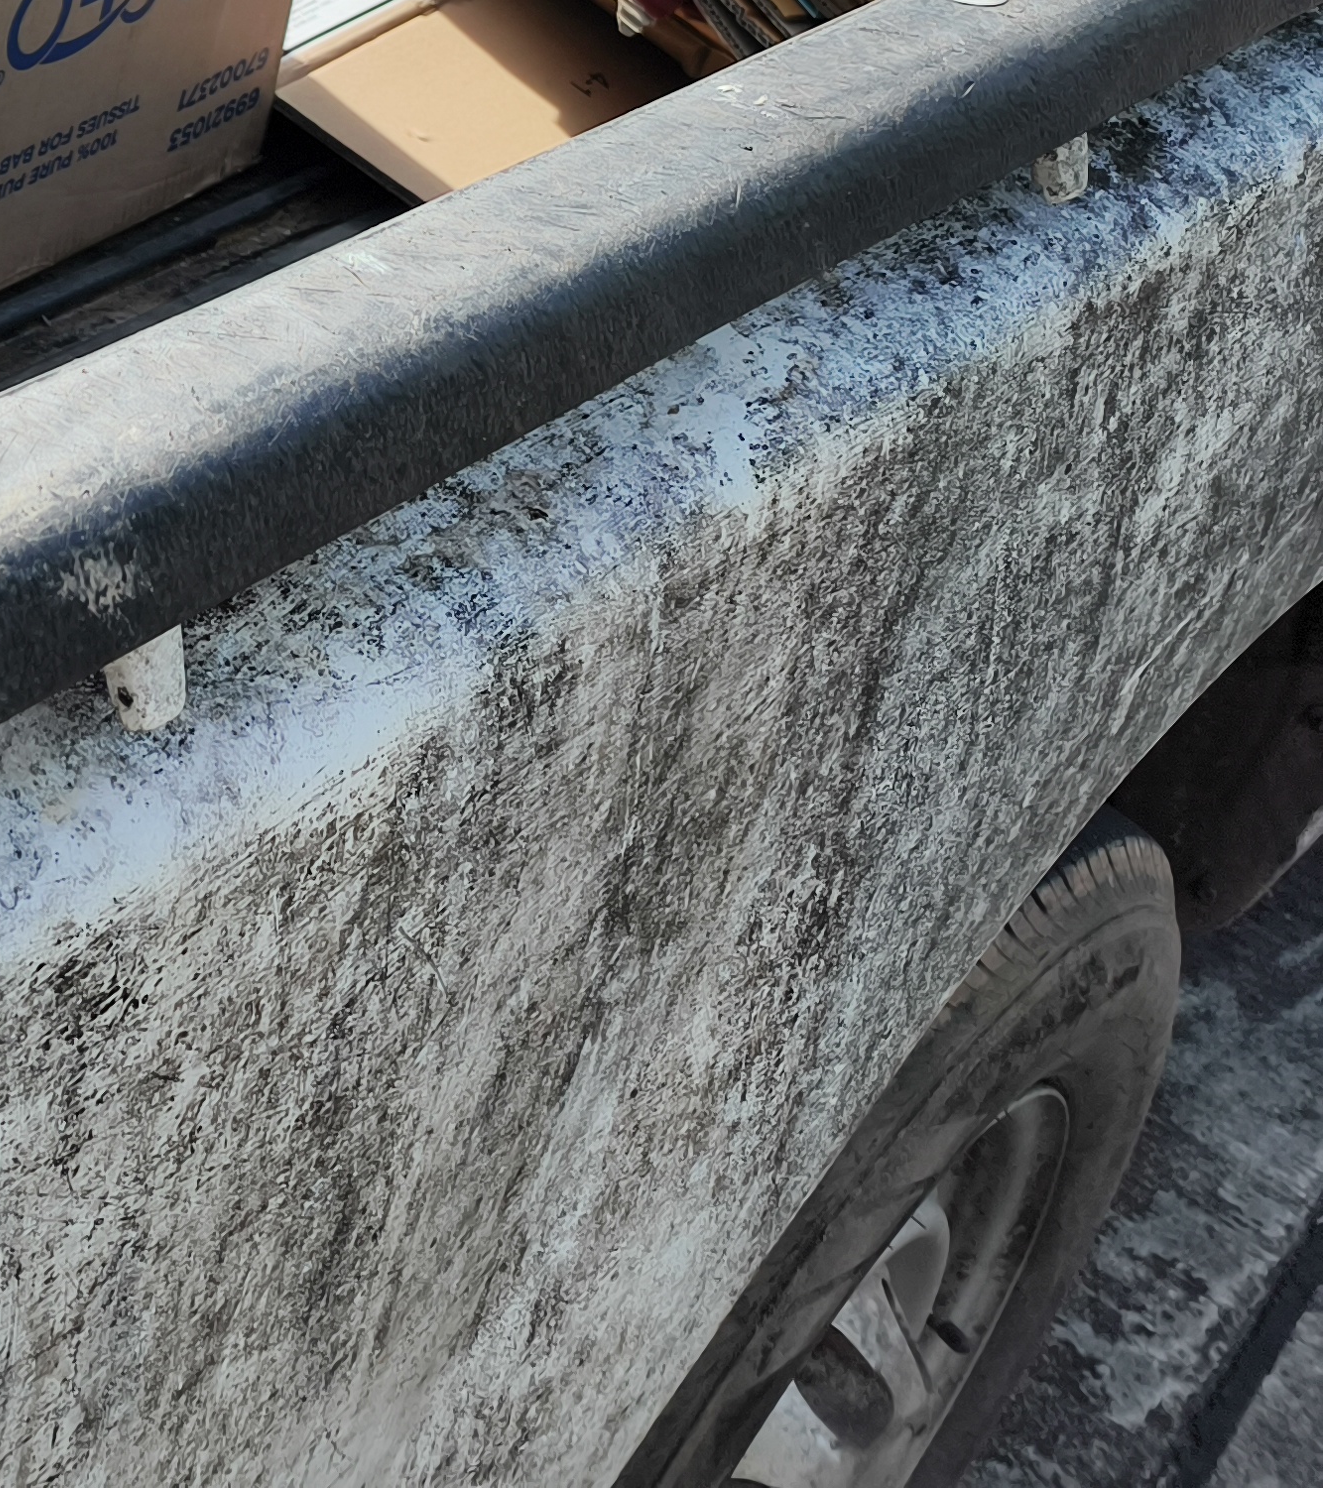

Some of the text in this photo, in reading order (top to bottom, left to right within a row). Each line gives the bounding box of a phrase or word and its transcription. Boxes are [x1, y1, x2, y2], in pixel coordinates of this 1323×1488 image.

[177, 47, 269, 112] 67002371
[77, 94, 139, 139] TISSUES
[167, 87, 261, 152] 69921053
[38, 125, 73, 157] FOR
[77, 129, 118, 162] 100%
[27, 150, 73, 185] PURE
